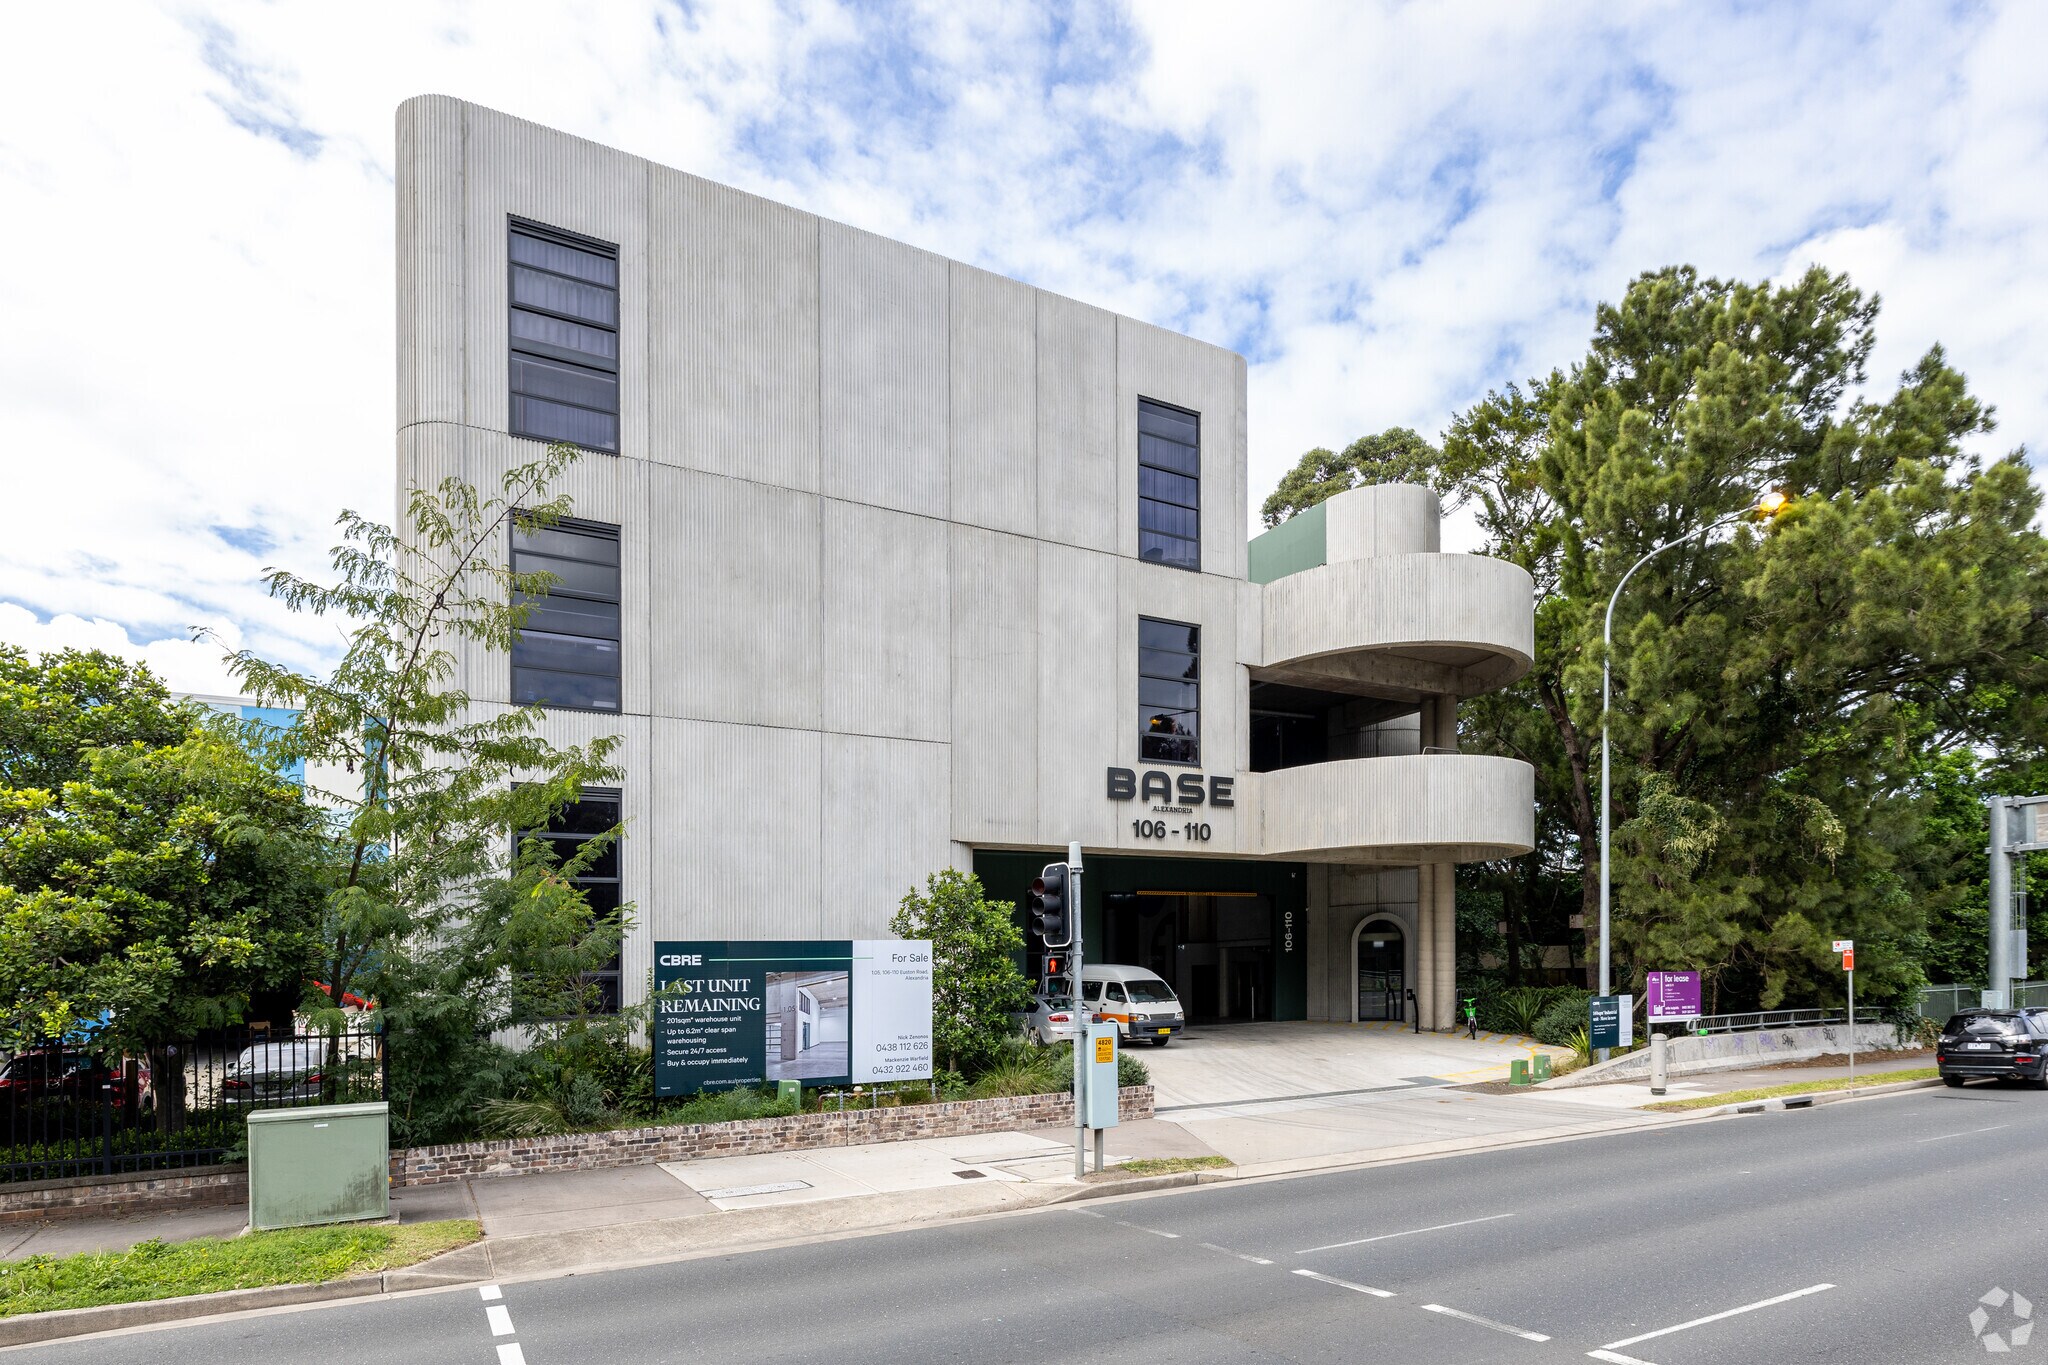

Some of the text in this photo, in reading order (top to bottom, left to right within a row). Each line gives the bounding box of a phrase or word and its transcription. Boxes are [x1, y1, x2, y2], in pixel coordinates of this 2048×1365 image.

[1108, 767, 1234, 806] BASE
[1152, 805, 1193, 814] ALEXANDRIA
[1133, 820, 1166, 838] 106
[1184, 822, 1211, 841] 110
[1284, 911, 1293, 952] 106-110
[660, 954, 702, 966] CBRE
[892, 953, 929, 963] For Sale
[1664, 974, 1673, 983] for
[1673, 974, 1690, 983] lease
[708, 979, 751, 993] UNIT
[660, 997, 761, 1013] REMAINING
[667, 1028, 676, 1036] Up
[690, 1047, 705, 1055] 24/7
[876, 1041, 929, 1052] 0438 112 626
[711, 1056, 748, 1064] immediately
[872, 1063, 929, 1075] 0432 922 460
[703, 1077, 762, 1086] cbre.com.au/properties
